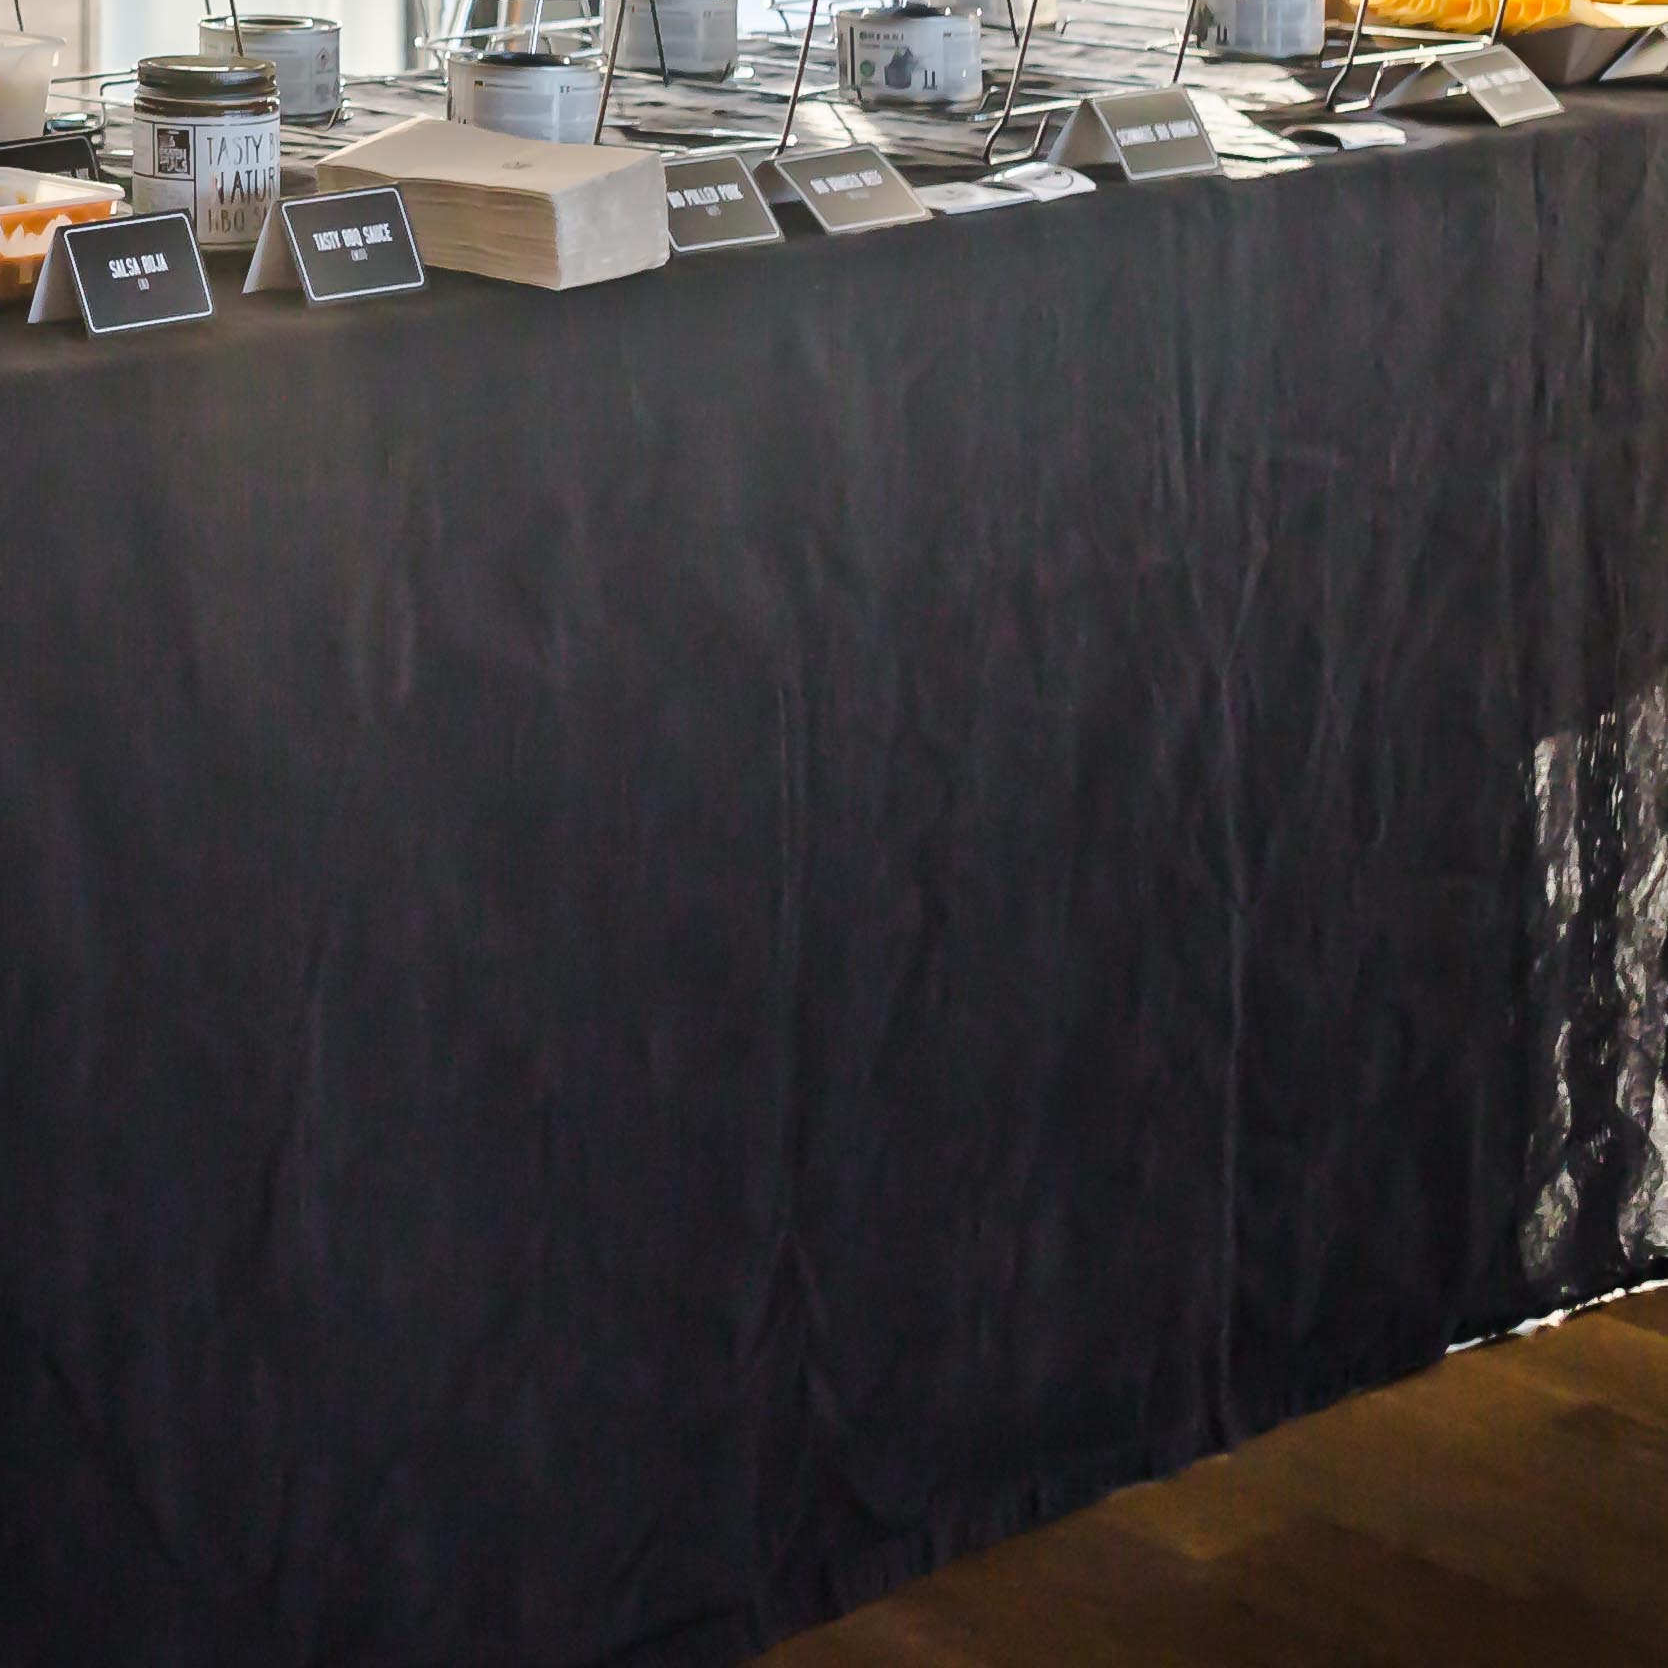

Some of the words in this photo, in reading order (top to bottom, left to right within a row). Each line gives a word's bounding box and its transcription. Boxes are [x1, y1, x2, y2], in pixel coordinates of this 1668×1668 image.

[206, 133, 264, 166] TASTY
[214, 166, 280, 206] NATUR
[108, 257, 141, 279] SALSA
